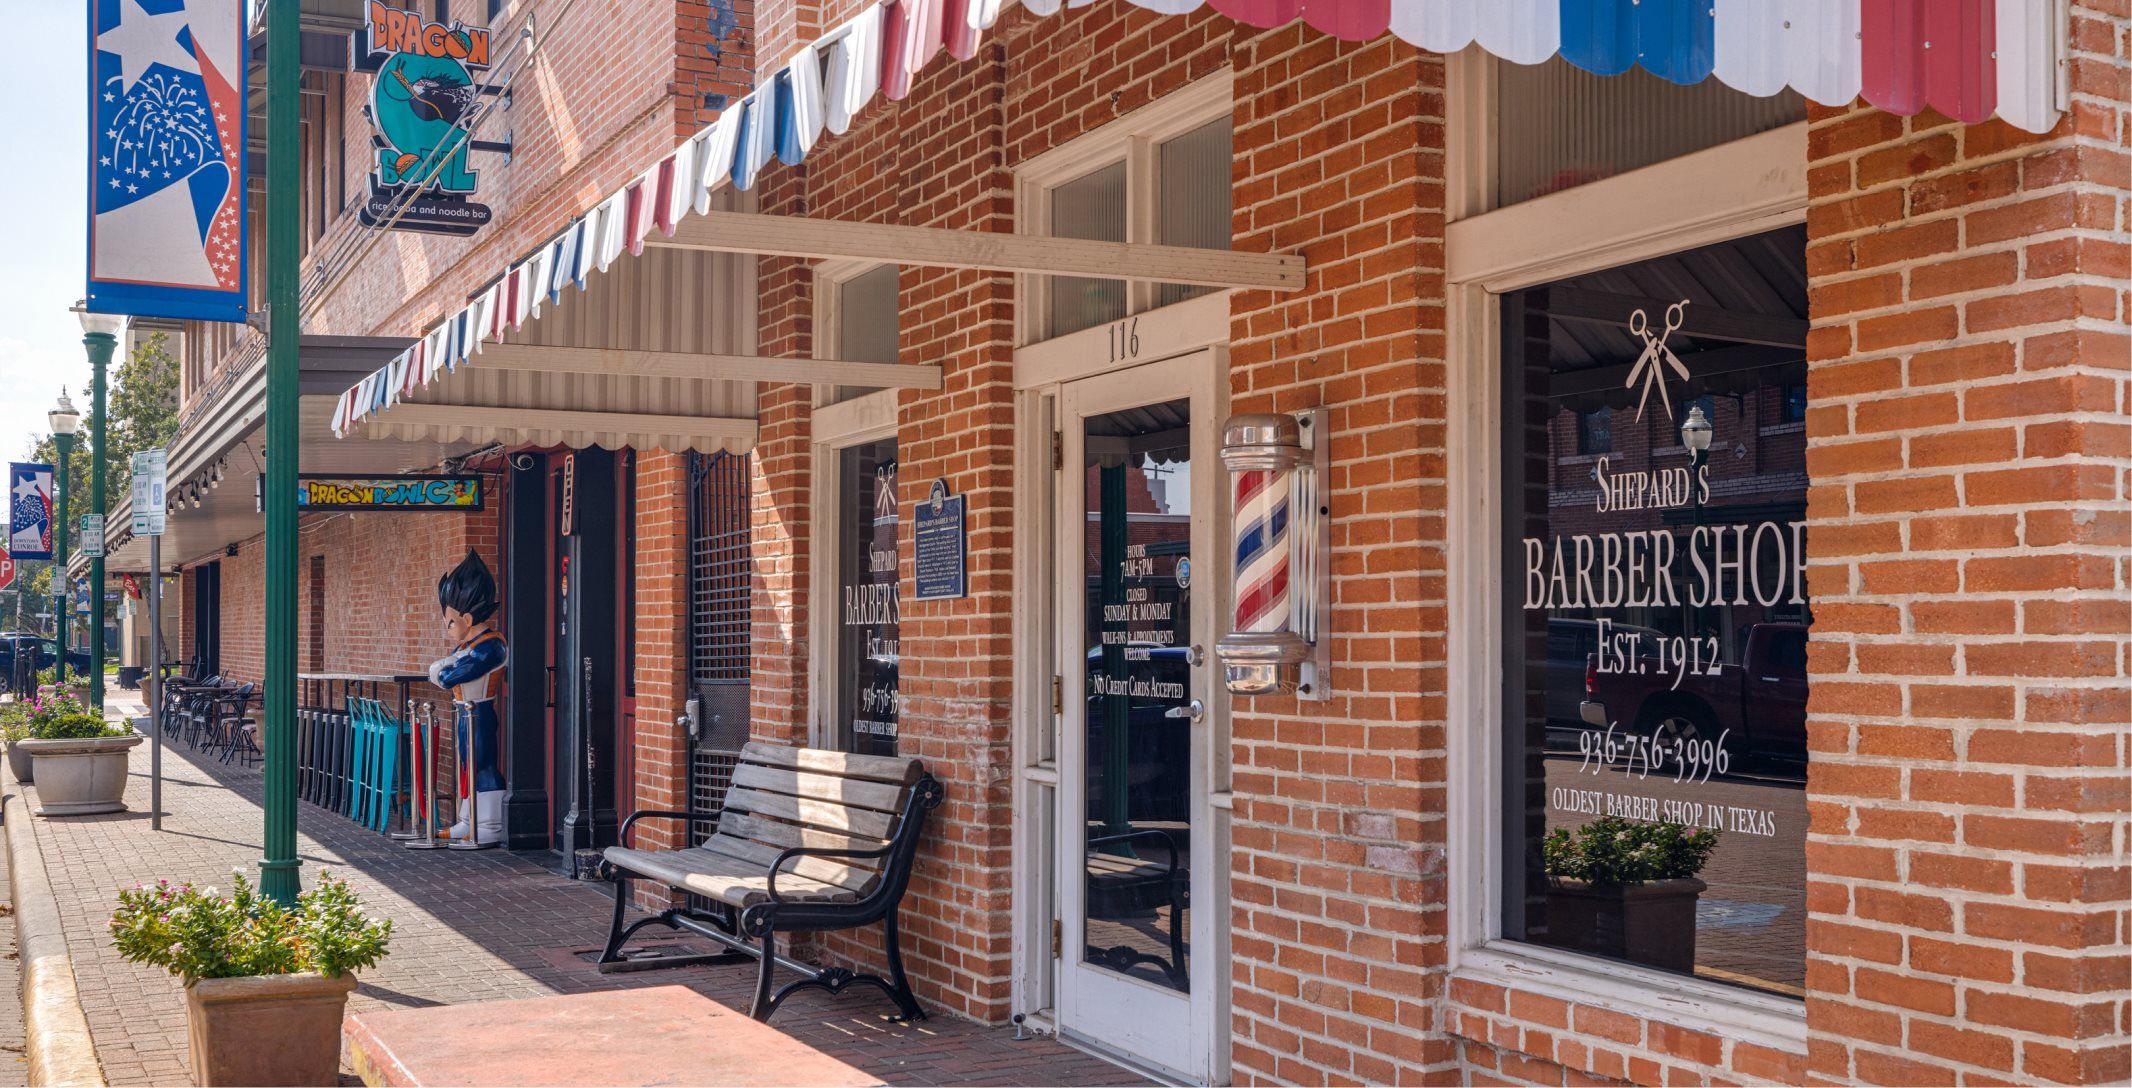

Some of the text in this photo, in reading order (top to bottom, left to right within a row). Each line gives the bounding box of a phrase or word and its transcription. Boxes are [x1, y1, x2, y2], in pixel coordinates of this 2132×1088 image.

[371, 1, 489, 64] DRAGON
[380, 142, 476, 190] BOWL
[420, 206, 436, 215] and
[439, 207, 470, 217] noodle
[472, 209, 487, 219] bar
[1109, 317, 1139, 363] 116
[1596, 446, 1710, 513] SHEPARD'S
[82, 517, 88, 529] 2
[869, 540, 899, 573] SHEPARD'
[1127, 544, 1146, 559] HOURS
[1120, 558, 1153, 583] 7AM-5PM
[1522, 529, 1681, 610] BARBER
[845, 583, 892, 625] BARBER
[1126, 588, 1148, 602] CLOSED
[1104, 603, 1172, 621] SUNDAY & MONDAY
[1102, 631, 1127, 645] WALK-INS
[1133, 630, 1174, 644] APPOINTMENTS
[884, 640, 898, 669] 191
[1124, 647, 1151, 661] WELCOME
[1596, 618, 1722, 691] EST. 1912
[863, 682, 899, 714] 936-756-39
[1094, 674, 1184, 699] NO CREDIT CARDS ACCEPTED
[853, 719, 868, 733] OLDEST
[869, 720, 885, 735] BARBER
[1579, 721, 1730, 785] 936-756-3996
[1552, 787, 1775, 837] OLDEST BARBER SHOP IN TEXAS
